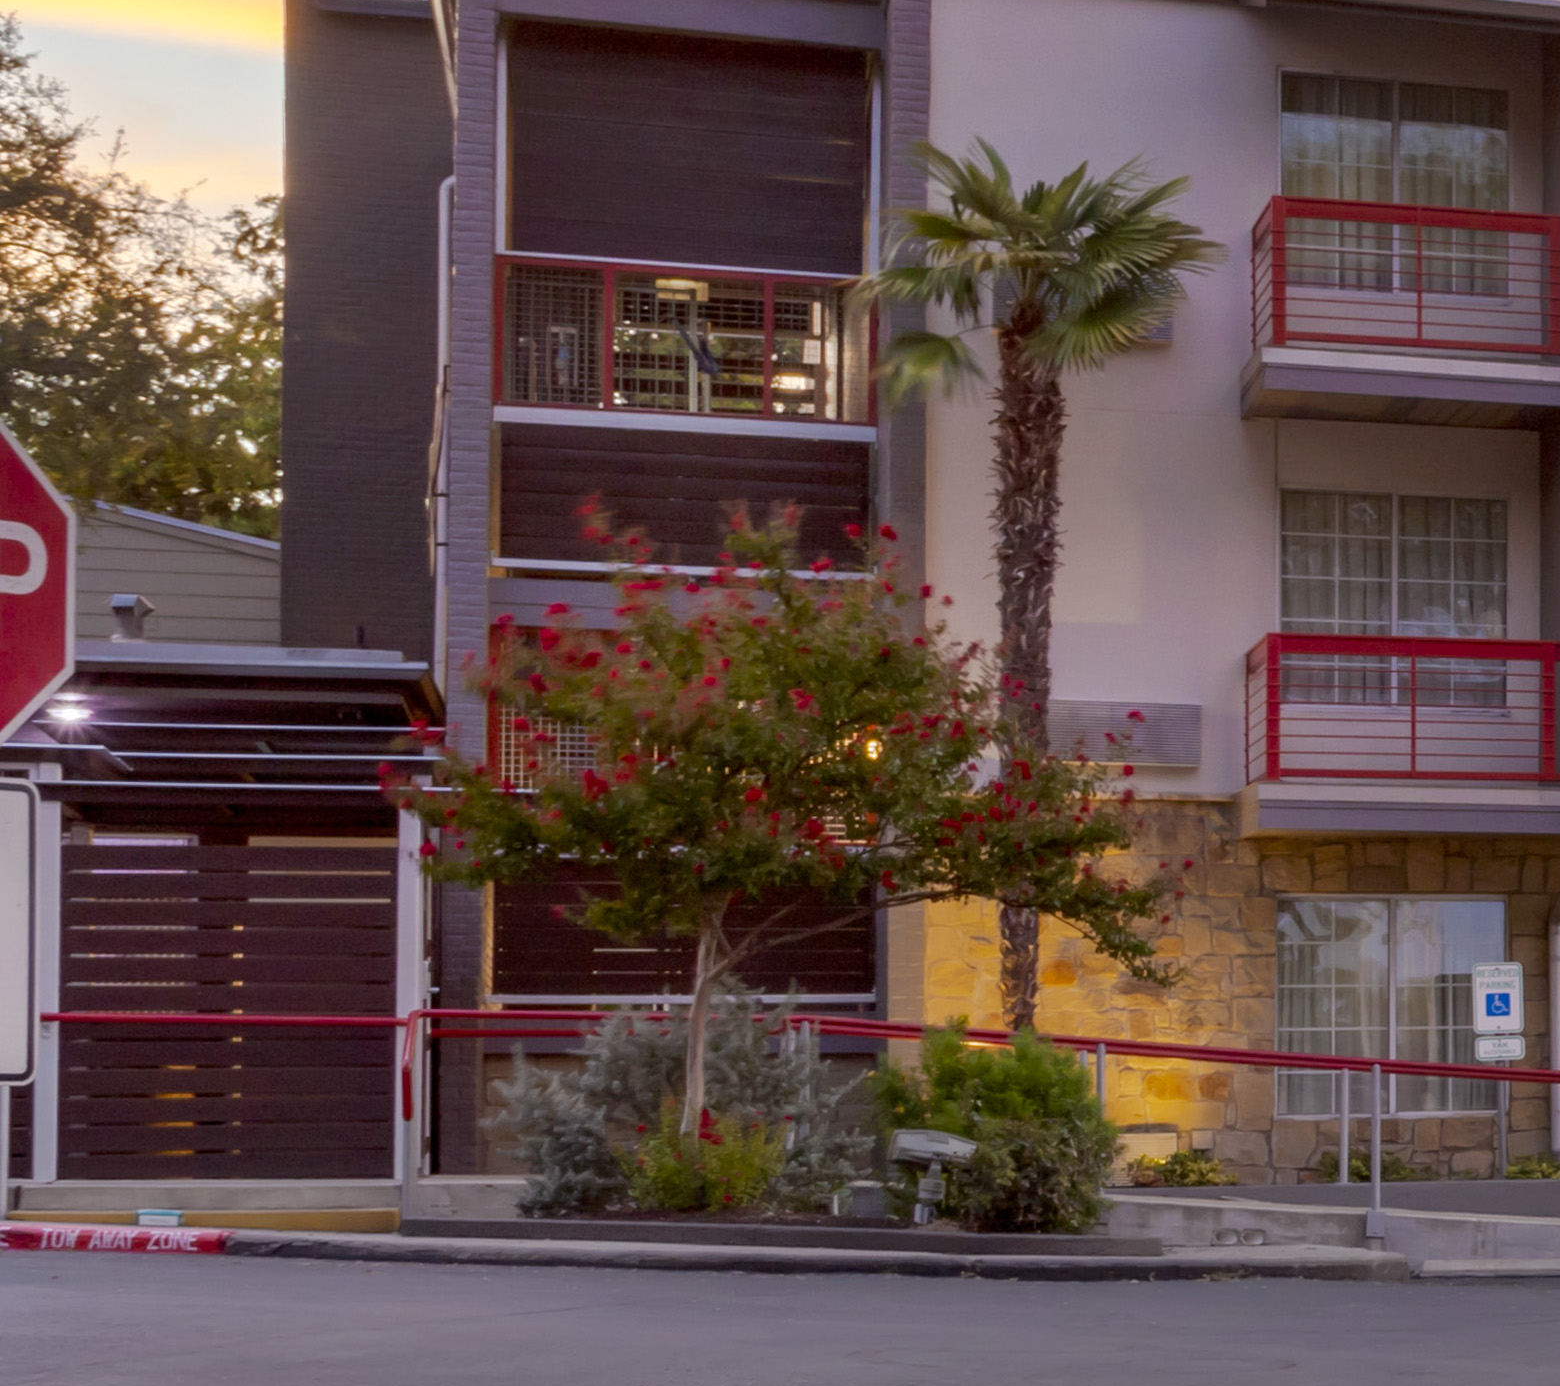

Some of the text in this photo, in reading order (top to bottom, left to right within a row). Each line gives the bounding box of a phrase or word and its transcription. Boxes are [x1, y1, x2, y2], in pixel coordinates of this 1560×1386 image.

[1480, 981, 1516, 989] PARKING
[40, 1228, 200, 1251] TOW AWAY ZONE
